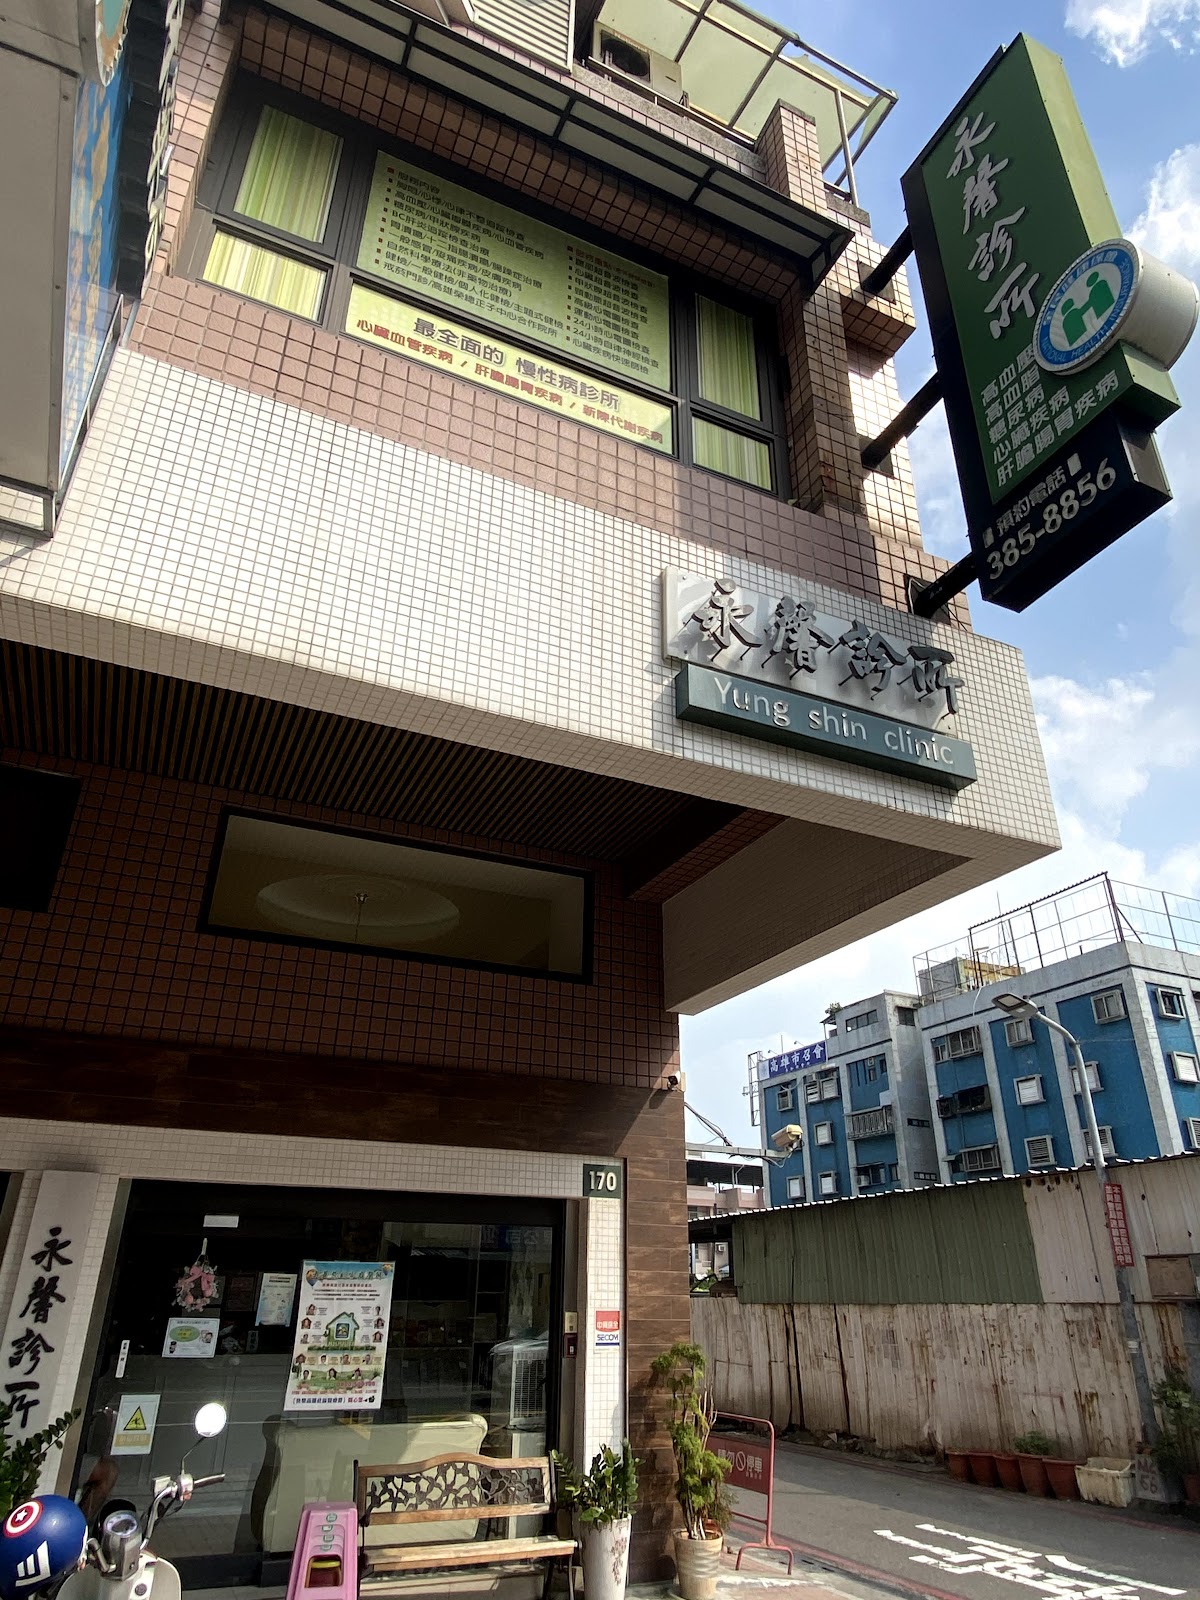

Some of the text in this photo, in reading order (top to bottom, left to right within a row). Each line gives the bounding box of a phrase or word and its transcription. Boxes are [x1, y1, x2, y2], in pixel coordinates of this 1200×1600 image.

[413, 317, 620, 411] 最全面的 慢性病診所
[1071, 325, 1109, 358] HEALTH
[985, 365, 1041, 426] 高血脂
[988, 386, 1045, 445] 糖尿病
[997, 369, 1119, 488] 肝膽腸胃疾病
[986, 458, 1117, 580] 385-8856
[996, 466, 1067, 536] 預約電話
[713, 677, 954, 766] Yung shin clinic
[770, 1043, 824, 1073] 高雄市召會
[588, 1170, 617, 1191] 170
[597, 1333, 619, 1341] SECOM
[747, 1455, 763, 1474] 停車
